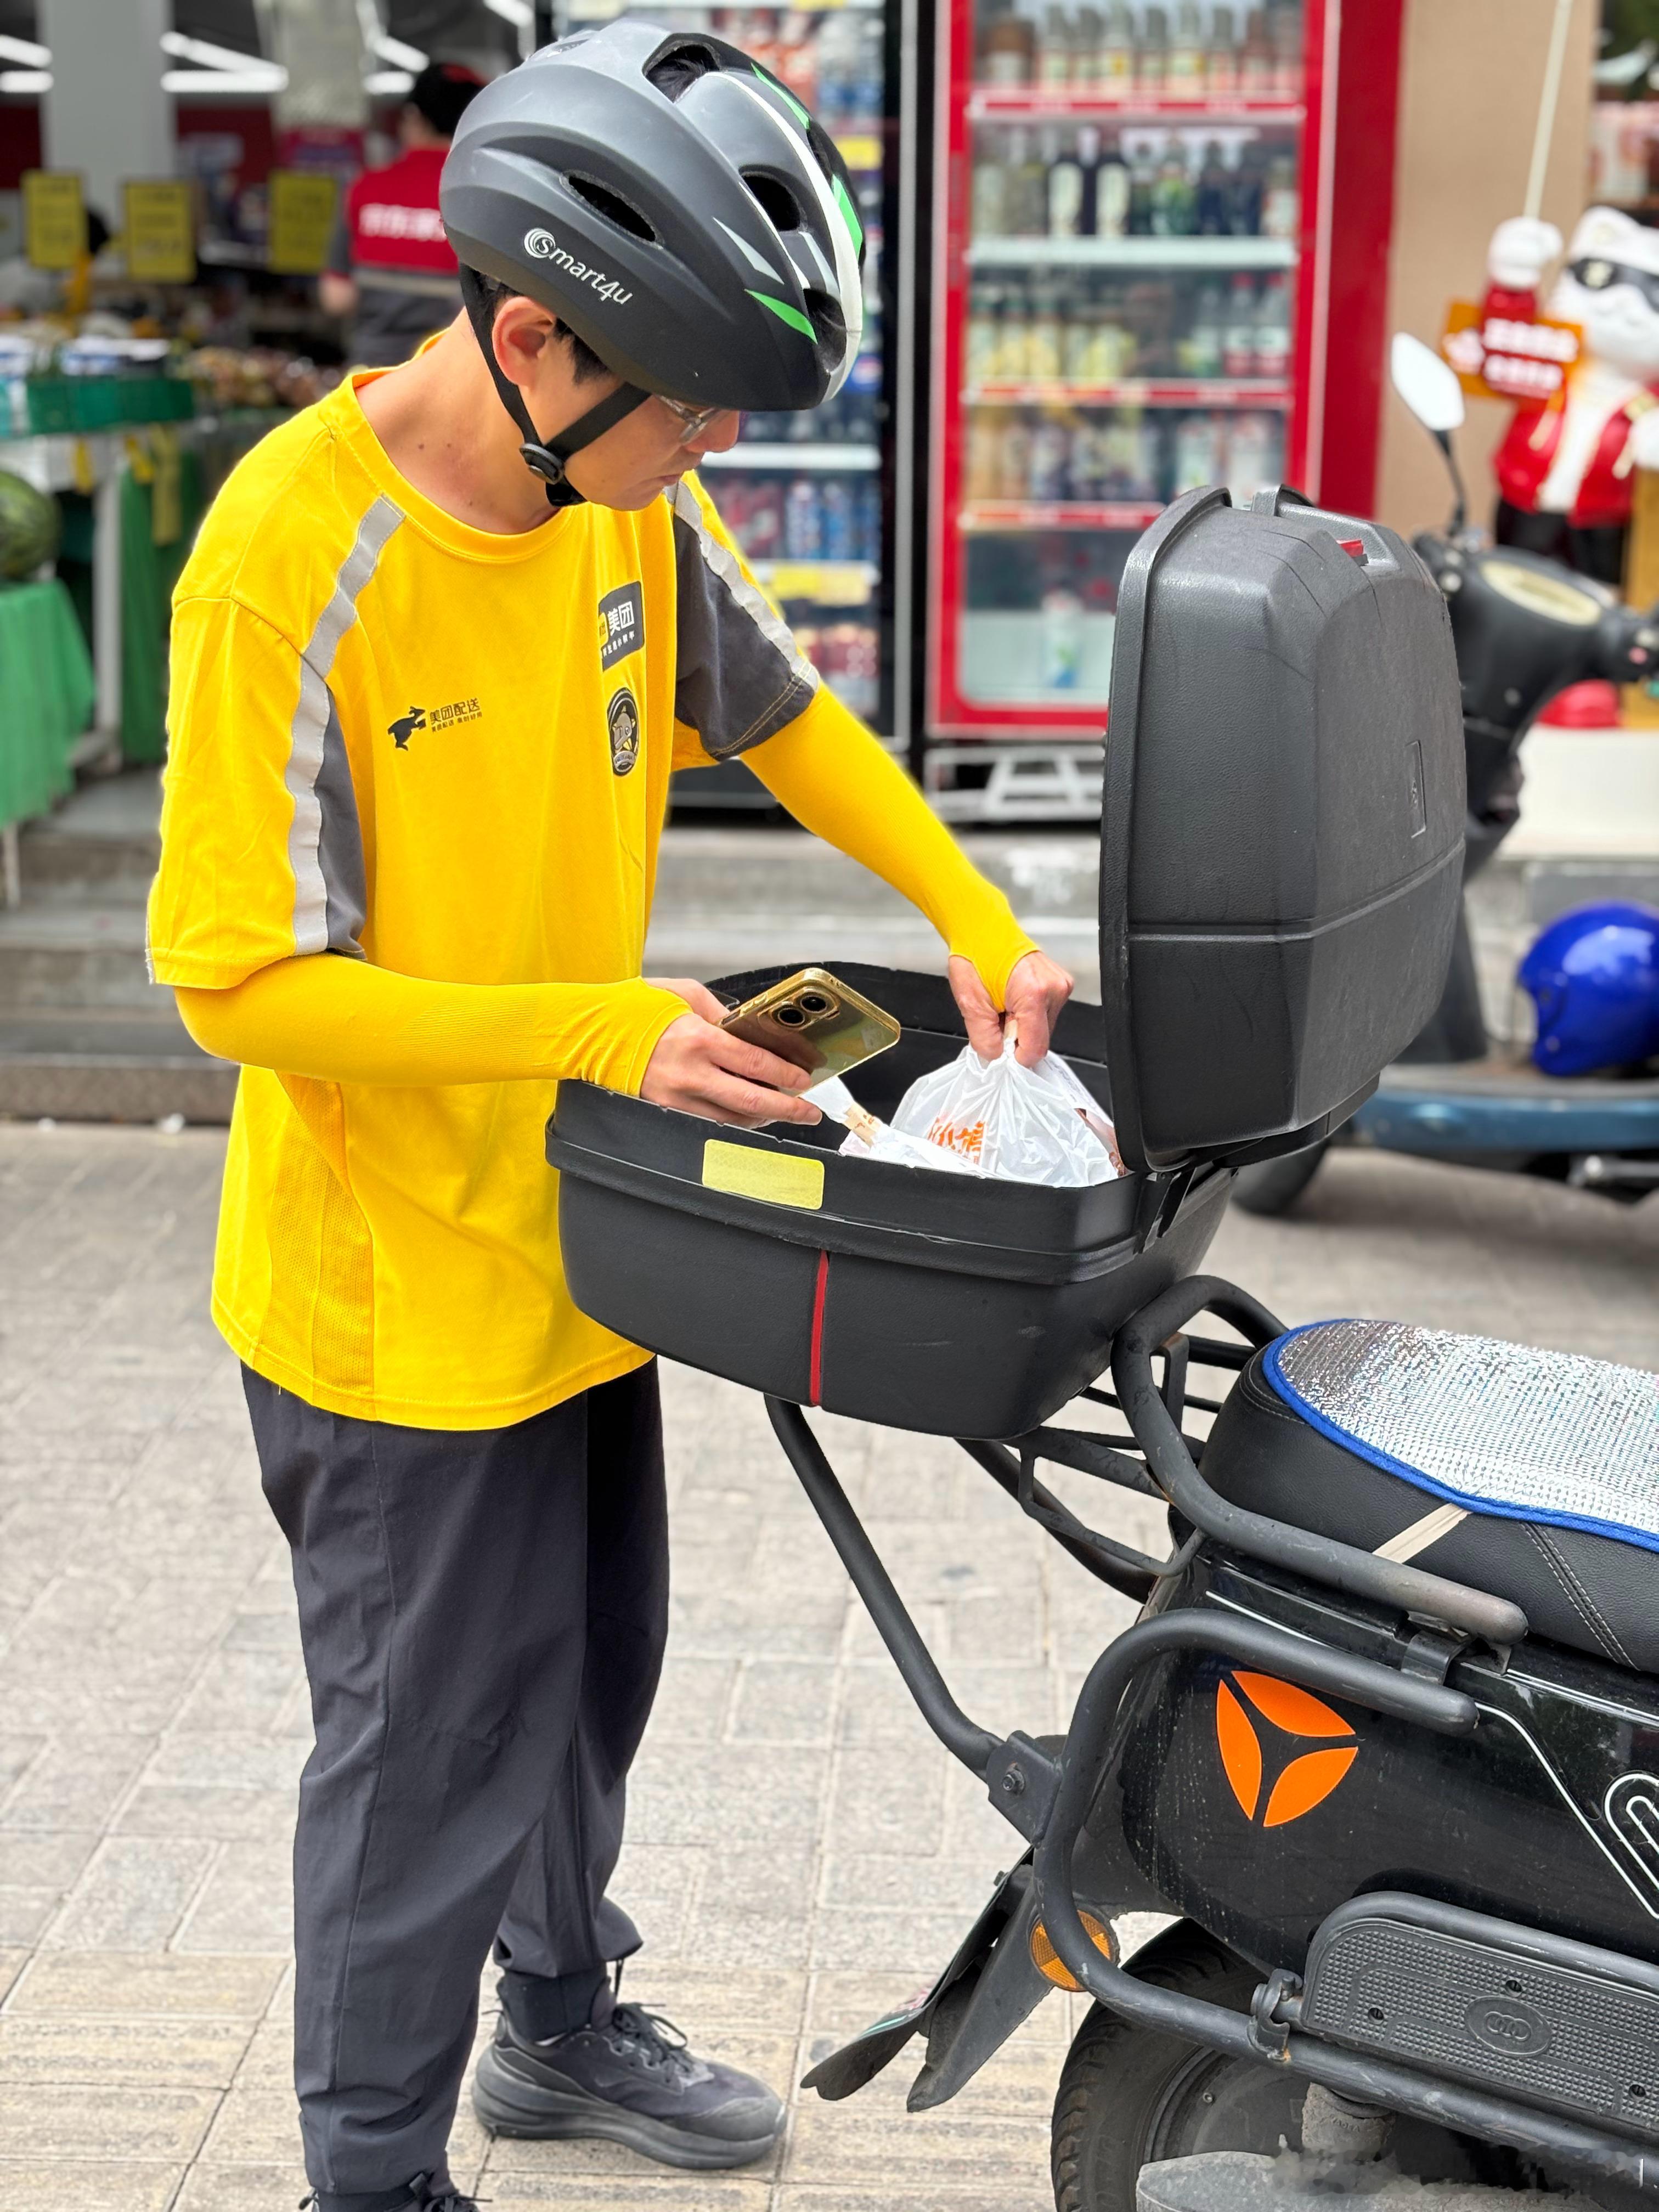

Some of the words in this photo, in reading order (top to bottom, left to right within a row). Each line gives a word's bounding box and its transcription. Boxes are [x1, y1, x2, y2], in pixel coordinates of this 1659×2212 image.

[524, 228, 633, 305] Smart4u
[607, 601, 635, 636] 美团
[430, 697, 481, 725] 美团配送
